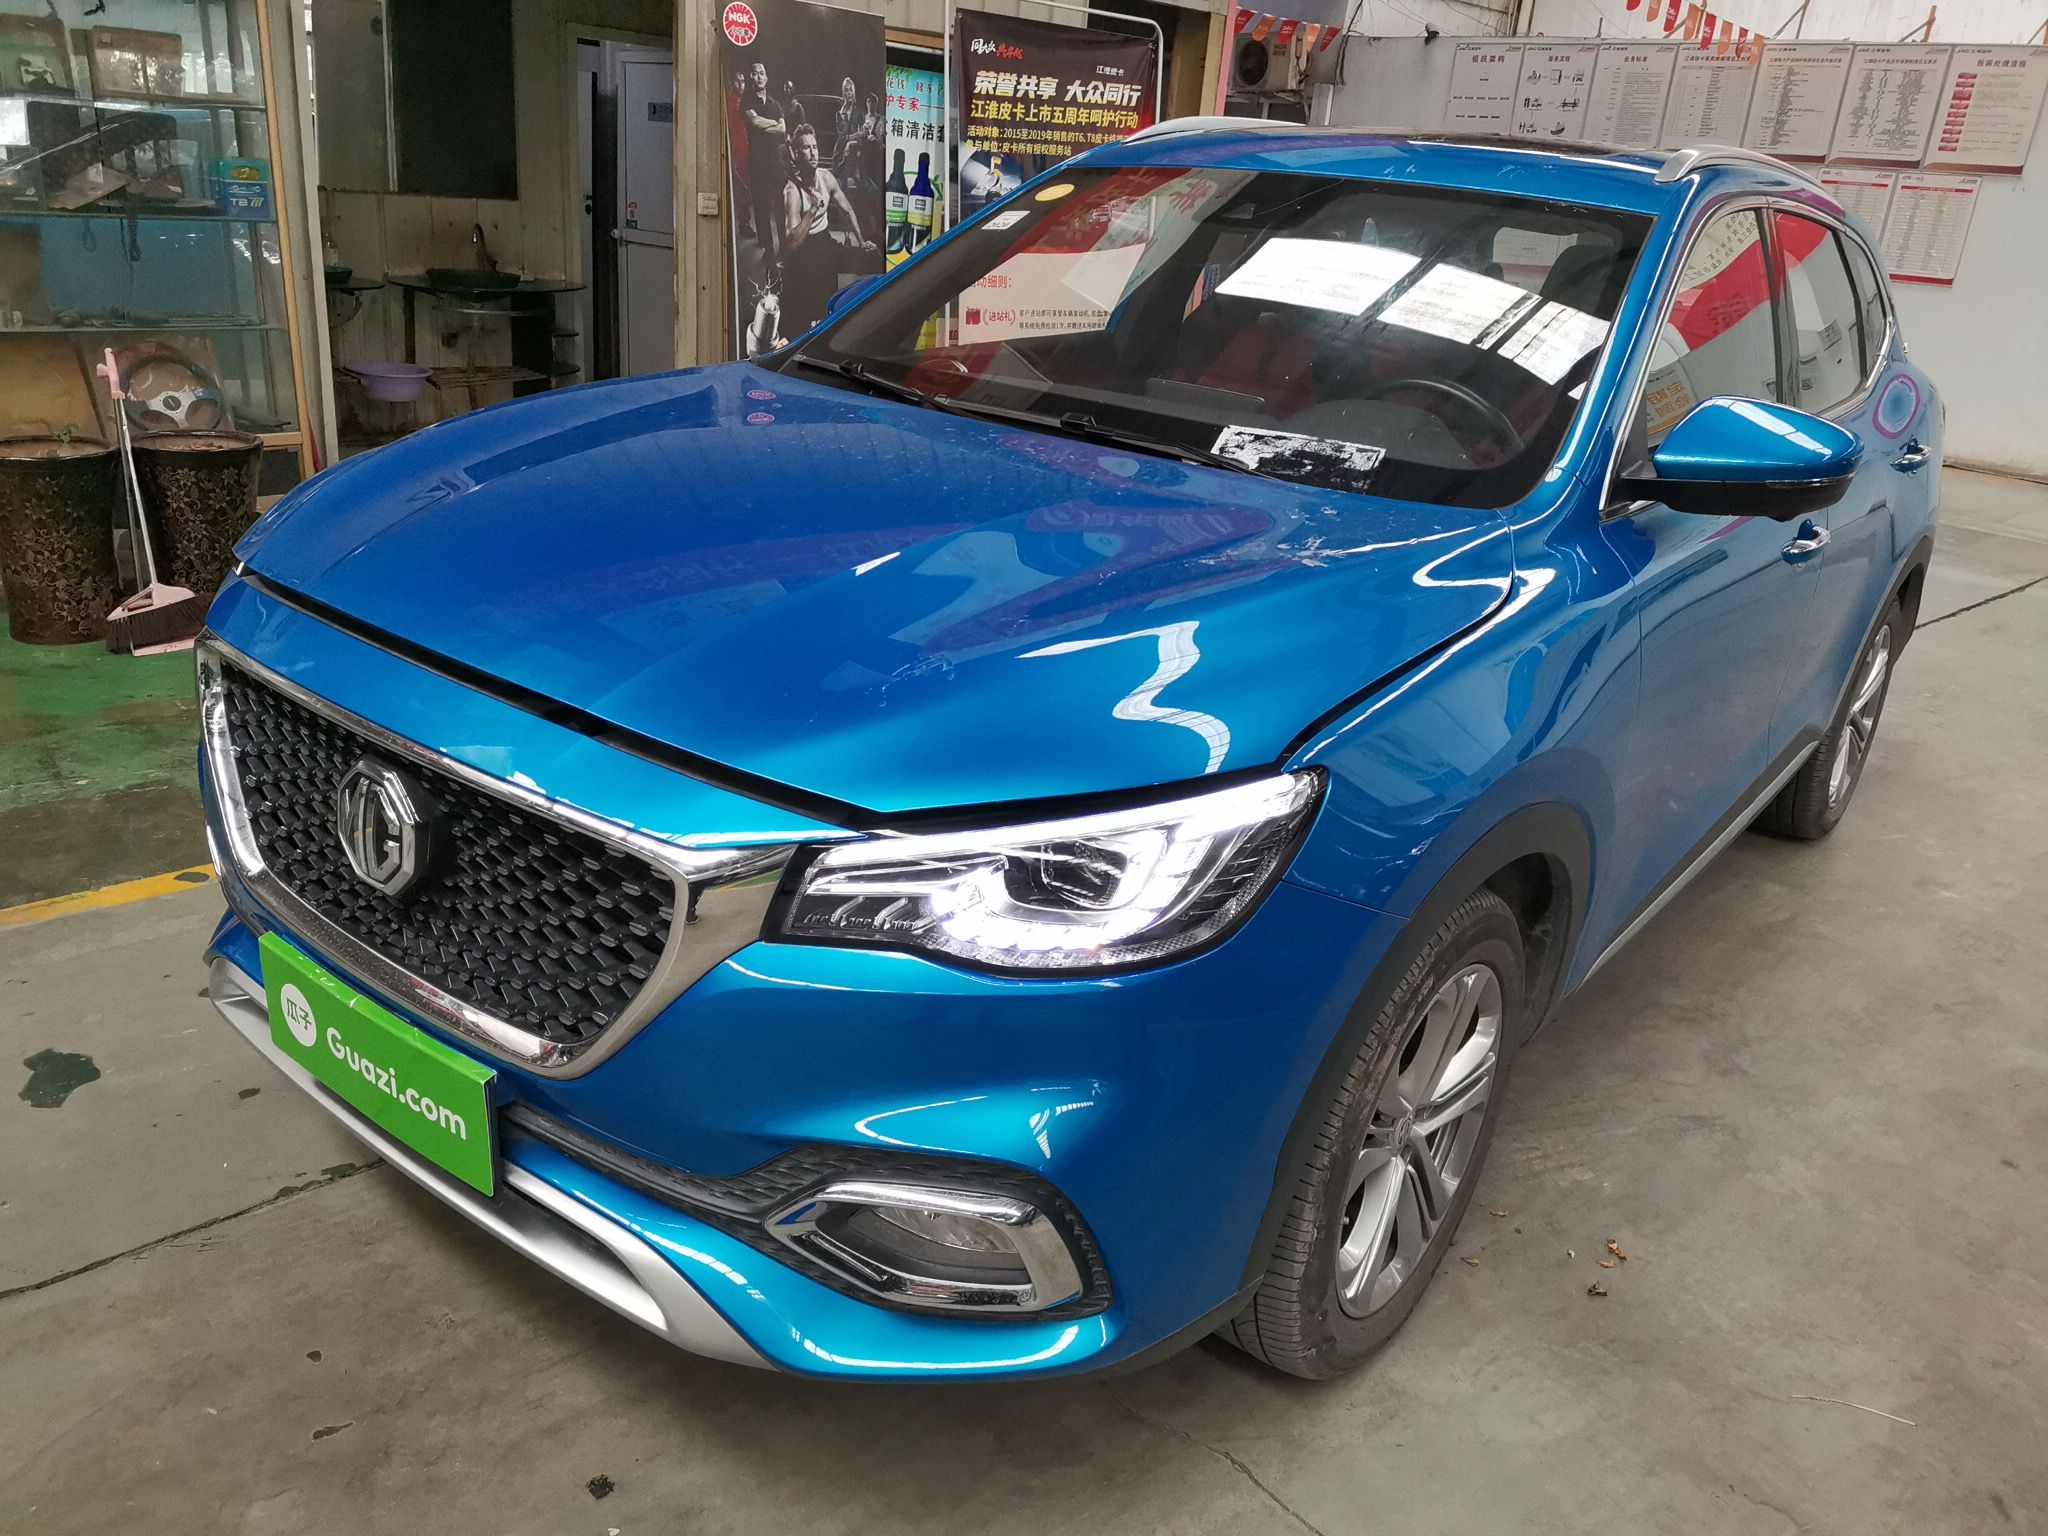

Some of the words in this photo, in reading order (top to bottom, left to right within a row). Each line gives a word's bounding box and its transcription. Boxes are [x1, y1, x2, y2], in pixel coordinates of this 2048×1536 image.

[729, 11, 751, 25] NGK
[1095, 65, 1125, 78] 江淮皮卡
[973, 70, 1059, 100] 荣誉共享
[1064, 79, 1142, 107] 大众同行
[885, 117, 944, 143] 箱清洁套
[970, 98, 1139, 130] 江淮皮卡上市五周年呵护行动
[968, 275, 1012, 289] 动细则：
[341, 777, 400, 882] MG
[286, 997, 312, 1031] 瓜子
[326, 1027, 467, 1141] Guazi.com
